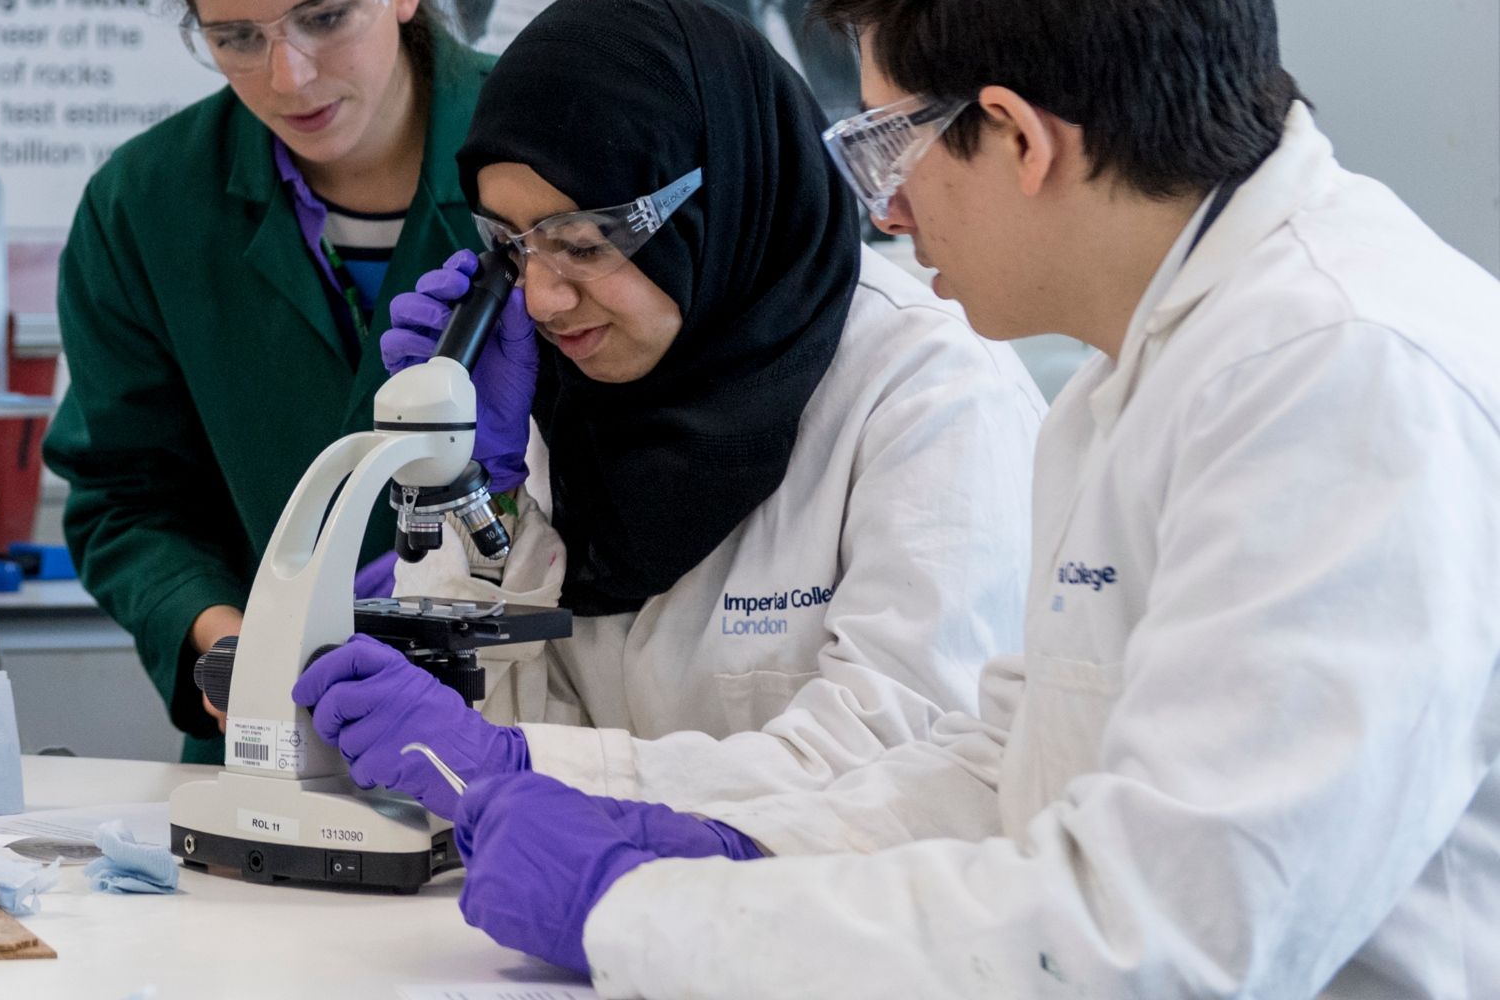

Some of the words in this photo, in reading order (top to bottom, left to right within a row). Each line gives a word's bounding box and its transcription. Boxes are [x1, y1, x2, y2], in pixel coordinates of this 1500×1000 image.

[57, 18, 90, 47] of
[95, 18, 144, 48] the
[32, 58, 116, 89] rocks
[0, 136, 88, 168] billion
[724, 591, 788, 617] Imperial
[791, 583, 837, 609] Colle
[721, 616, 789, 636] London
[252, 818, 270, 830] ROL
[272, 822, 280, 832] 11
[321, 828, 365, 842] 1313090
